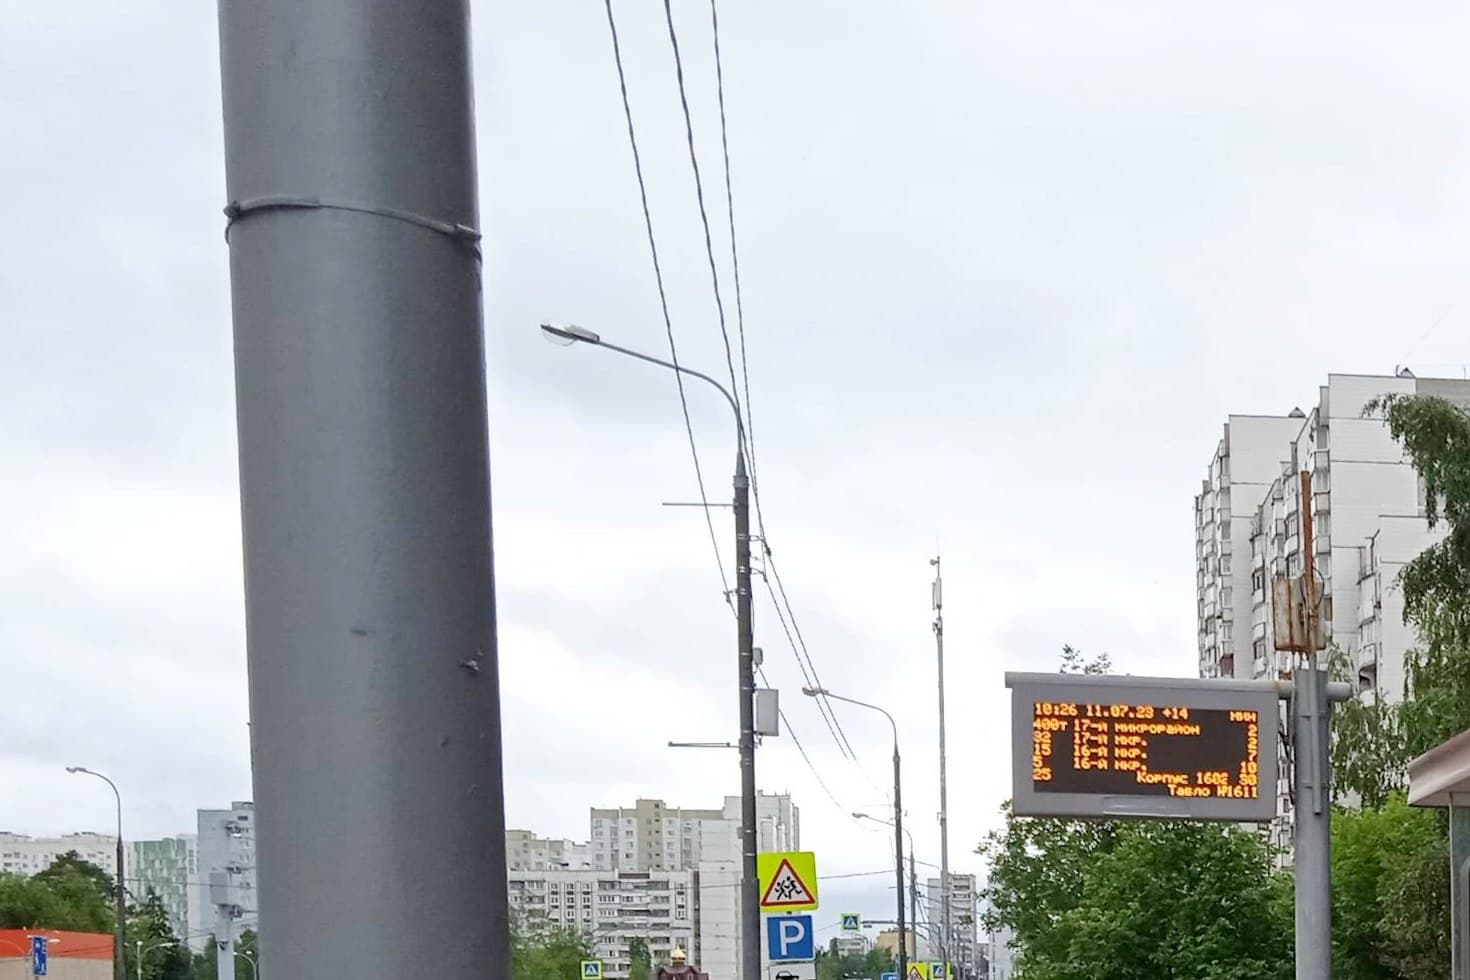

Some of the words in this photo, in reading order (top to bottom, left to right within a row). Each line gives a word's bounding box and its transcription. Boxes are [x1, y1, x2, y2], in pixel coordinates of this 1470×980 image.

[1035, 703, 1078, 716] 10:26
[1086, 705, 1154, 719] 11.07.23
[1162, 707, 1188, 720] +14
[1248, 724, 1257, 737] 2
[1248, 737, 1257, 749] 2
[1034, 744, 1051, 756] 15
[1248, 749, 1257, 762] 7
[1032, 756, 1043, 768] 5
[1240, 761, 1257, 774] 10
[1033, 768, 1052, 780] 25
[1136, 770, 1189, 785] Корпус
[1168, 784, 1211, 797] Табло
[779, 920, 805, 956] P
